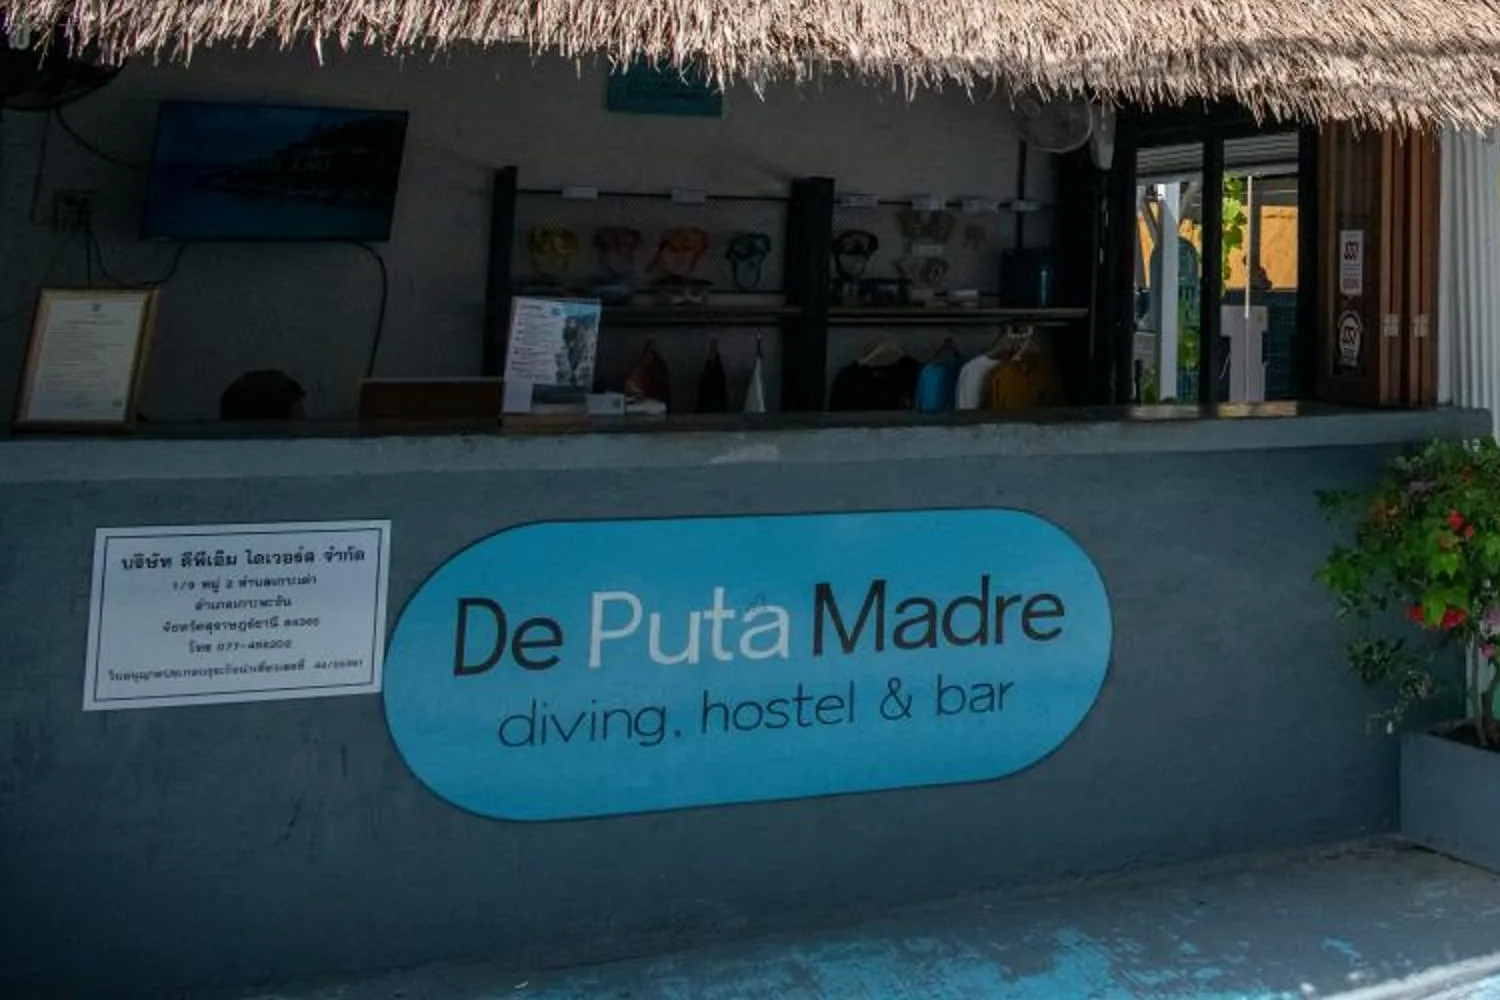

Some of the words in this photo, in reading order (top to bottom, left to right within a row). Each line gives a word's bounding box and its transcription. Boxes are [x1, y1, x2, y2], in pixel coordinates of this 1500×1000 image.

[121, 552, 173, 570] บริษัท
[324, 545, 365, 563] จำกัด
[452, 597, 564, 677] De
[587, 586, 790, 669] Puta
[811, 573, 1066, 656] Madre
[700, 679, 856, 734] hostel
[879, 676, 913, 722] &
[936, 673, 1015, 716] bar
